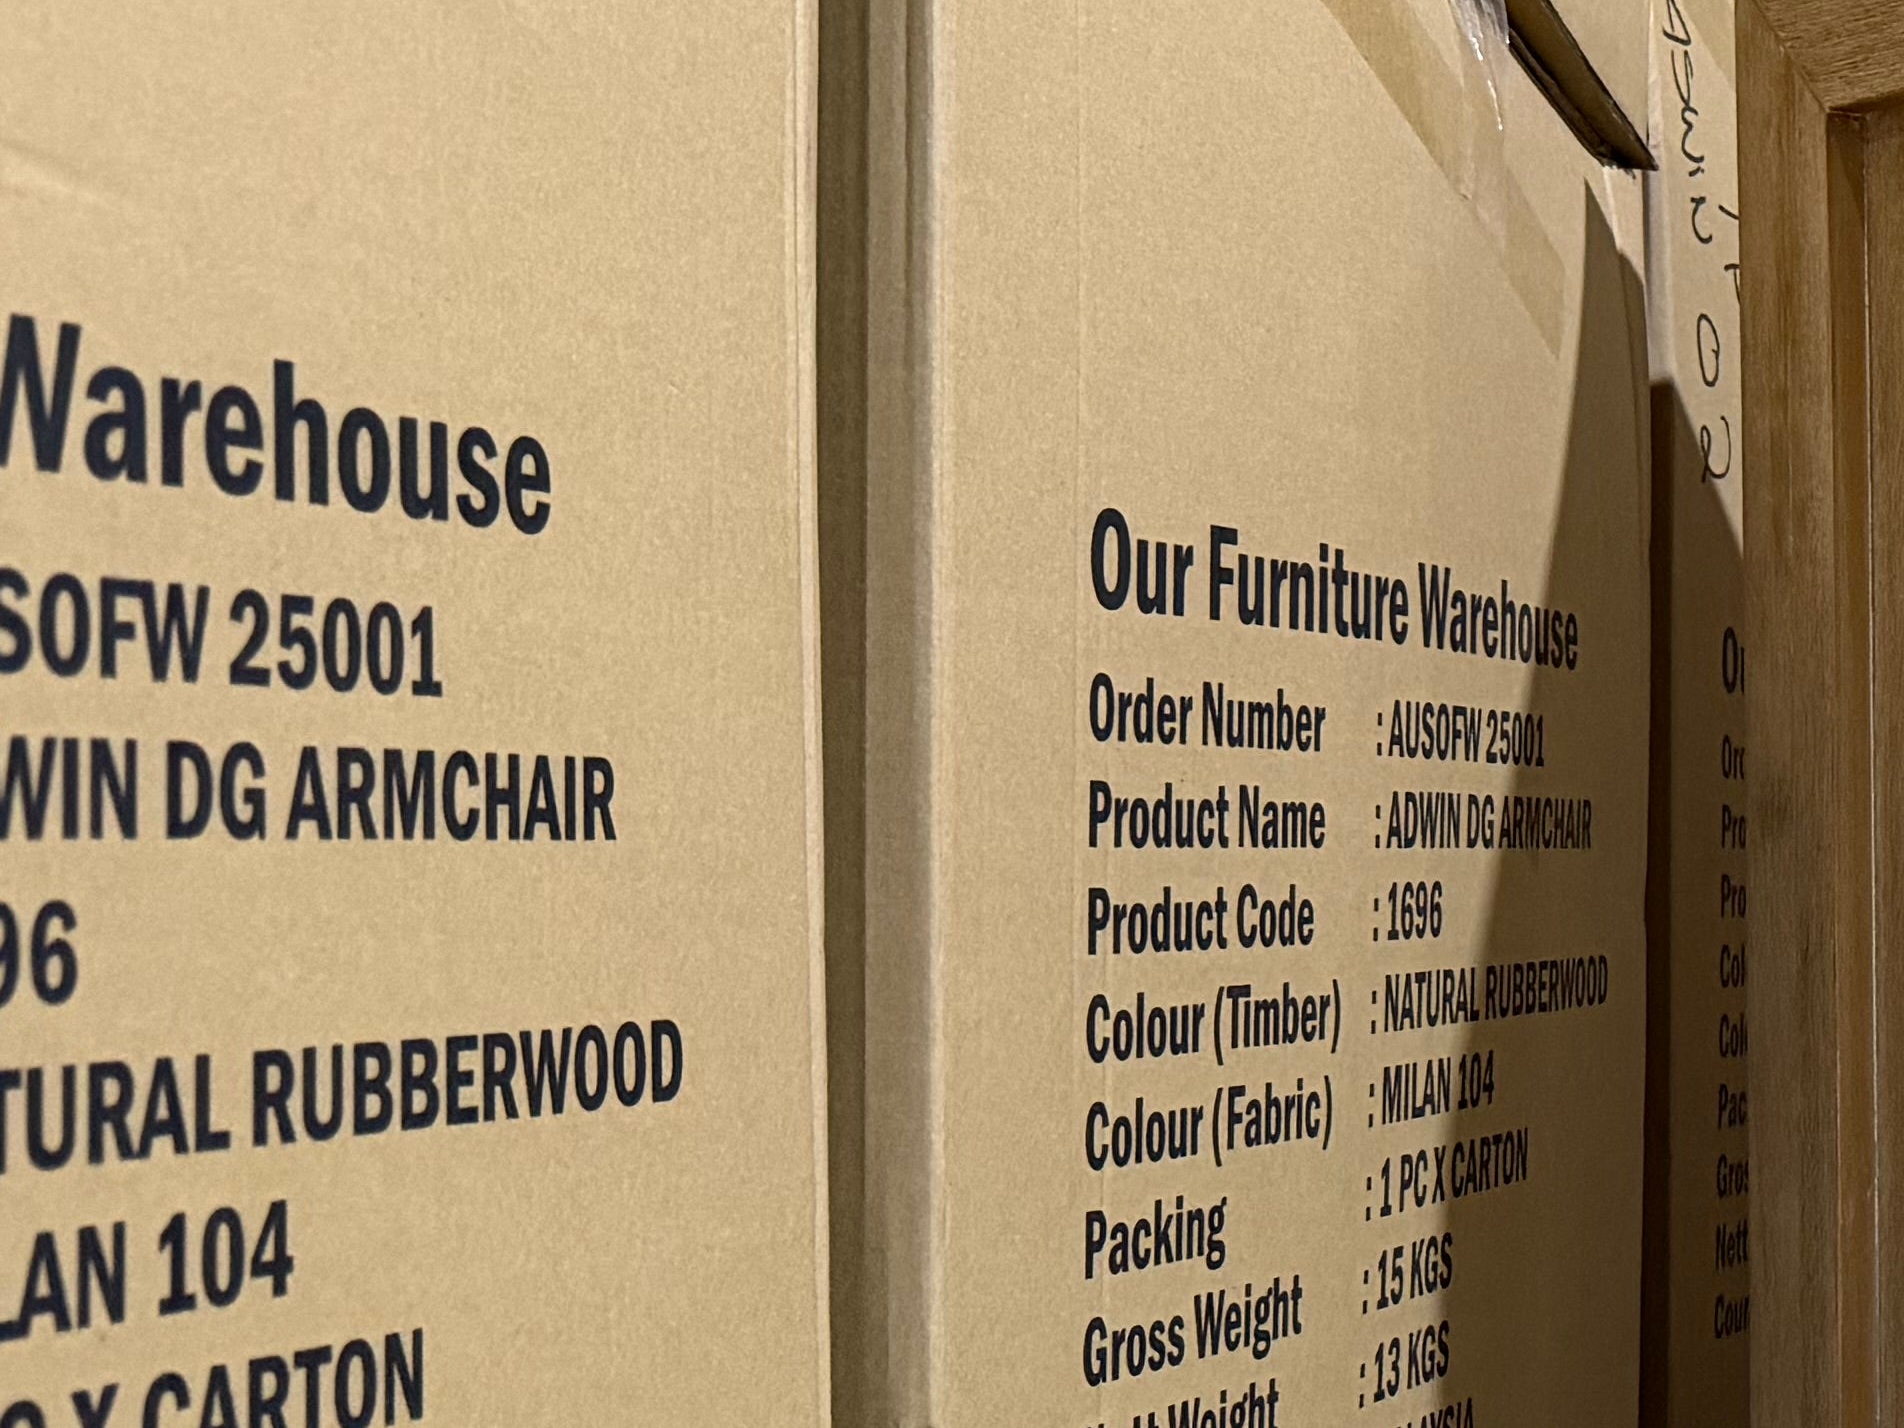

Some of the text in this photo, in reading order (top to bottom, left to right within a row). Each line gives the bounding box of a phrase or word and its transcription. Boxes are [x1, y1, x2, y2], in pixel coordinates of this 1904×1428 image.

[0, 313, 550, 535] Warehouse
[230, 589, 442, 697] 25001
[1091, 508, 1577, 670] Our Furniture Warehouse
[1089, 673, 1544, 767] Order Number AUSOFW 25001
[167, 741, 266, 840] DG
[285, 746, 616, 841] ARMCHAIR
[1089, 780, 1591, 849] Product Name ADWIN DG ARMCHAIR
[1088, 881, 1442, 955] Product Code 1696
[1086, 955, 1607, 1066] Colour (Timber) NATURAL RUBBERWOOD
[253, 1019, 683, 1146] RUBBERWOOD
[1085, 1050, 1494, 1171] Colour (Fabric) MILAN 104
[159, 1200, 294, 1315] 104
[1085, 1128, 1527, 1280] Packing 1 PC X CARTON
[1083, 1232, 1453, 1387] Gross Weight 15 KGS
[1374, 1338, 1400, 1403] 13
[1407, 1320, 1450, 1389] KGS
